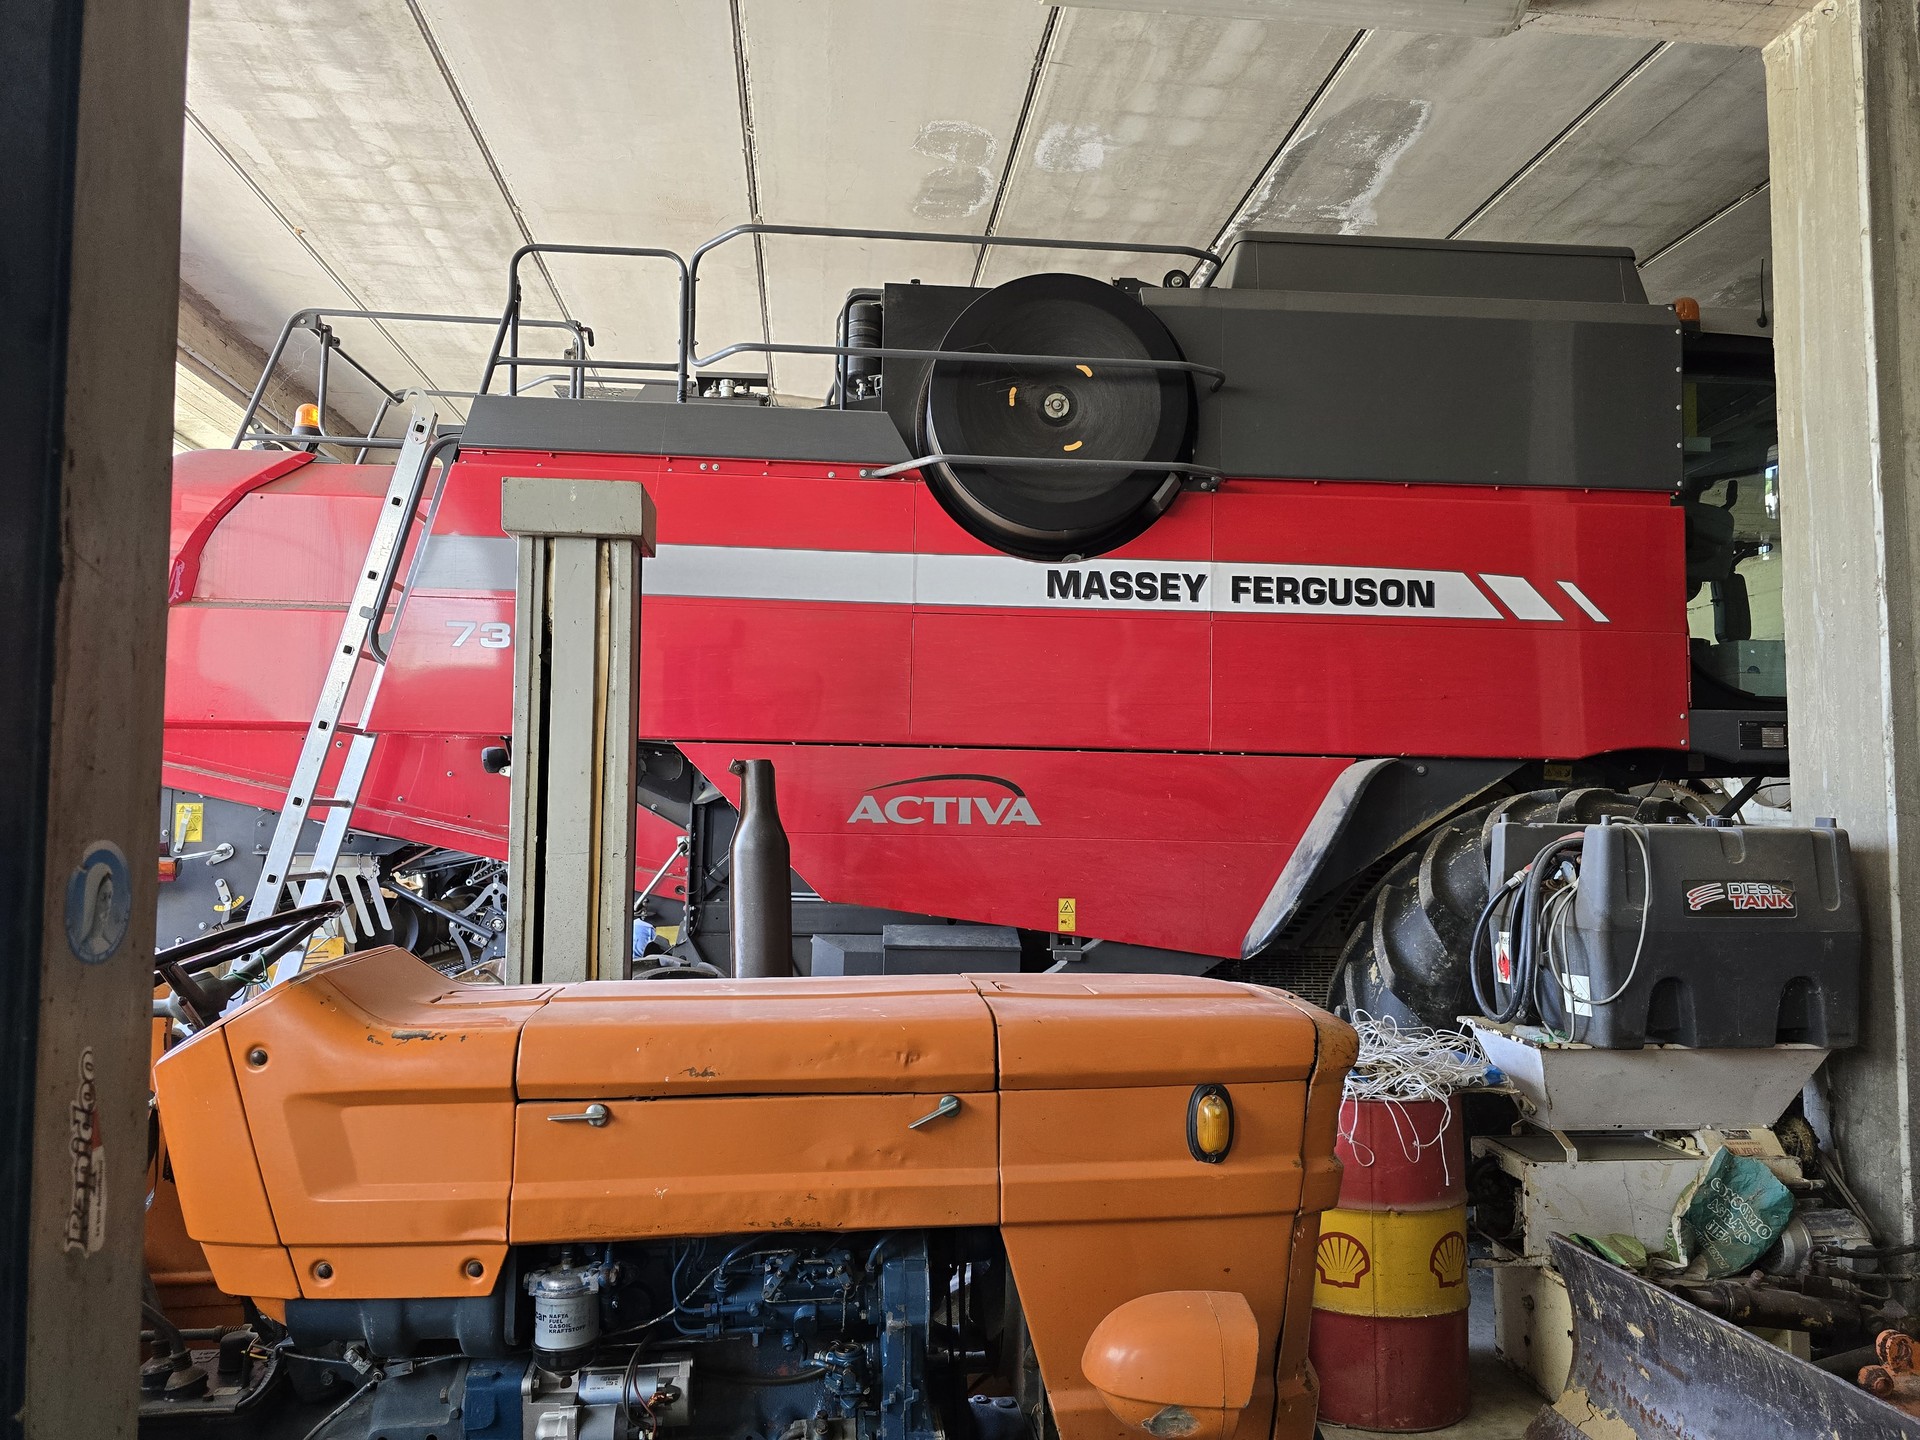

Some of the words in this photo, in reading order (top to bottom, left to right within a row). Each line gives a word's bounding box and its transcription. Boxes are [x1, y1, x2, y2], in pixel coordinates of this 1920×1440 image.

[1046, 569, 1208, 603] MASSEY
[1231, 575, 1436, 609] FERGUSON
[445, 620, 511, 649] 73
[846, 795, 1042, 826] ACTIVA
[1727, 883, 1786, 896] DIESE
[1728, 894, 1794, 910] TANK
[549, 1324, 586, 1334] KRAFTSTOFF
